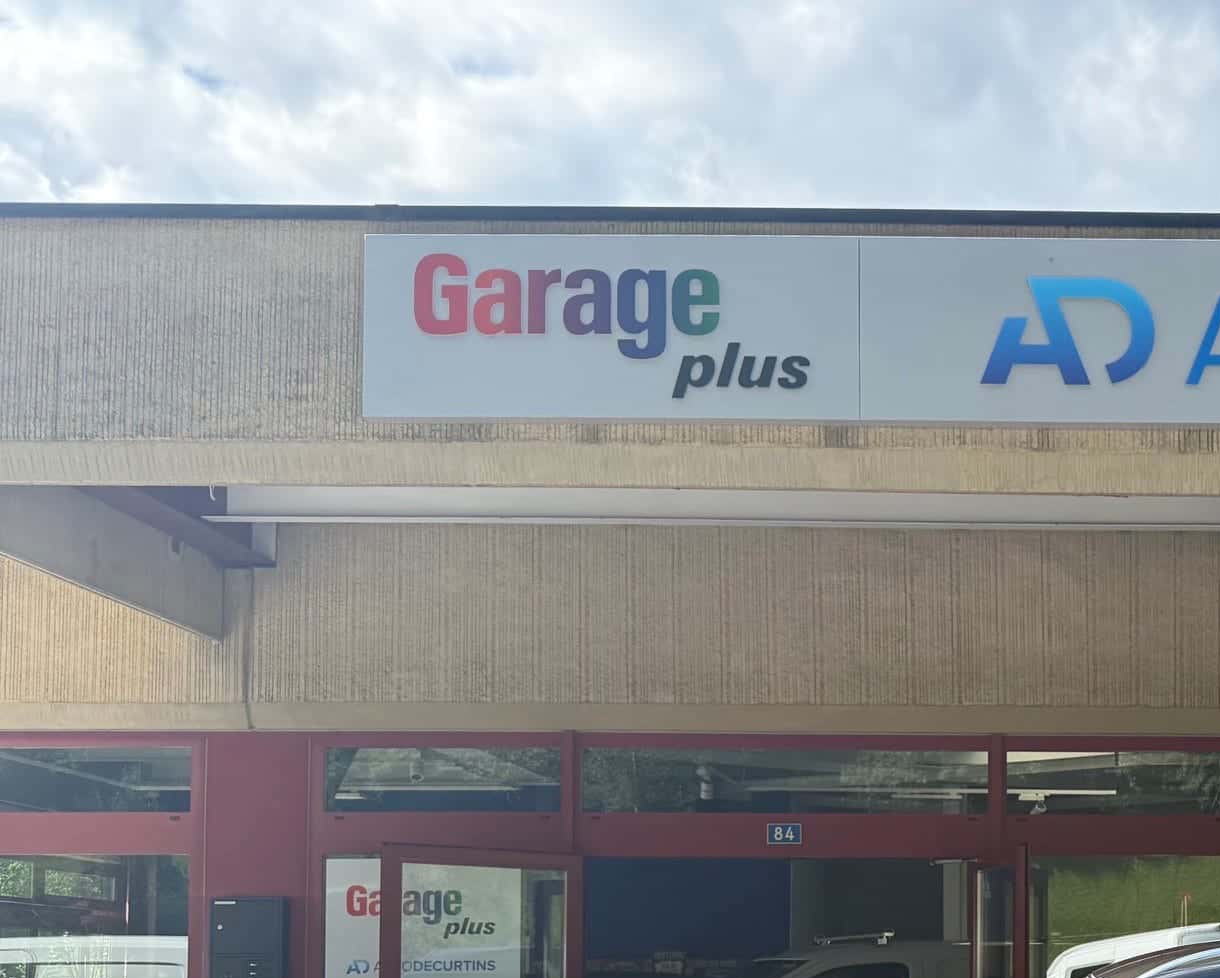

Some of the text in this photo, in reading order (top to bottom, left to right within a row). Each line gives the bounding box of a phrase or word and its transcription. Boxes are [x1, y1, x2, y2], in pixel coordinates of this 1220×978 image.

[413, 252, 721, 360] Garage
[671, 341, 812, 399] plus
[774, 826, 795, 841] 84
[346, 884, 463, 925] Gaage
[443, 917, 497, 940] plus
[373, 959, 497, 973] AODECURTINS
